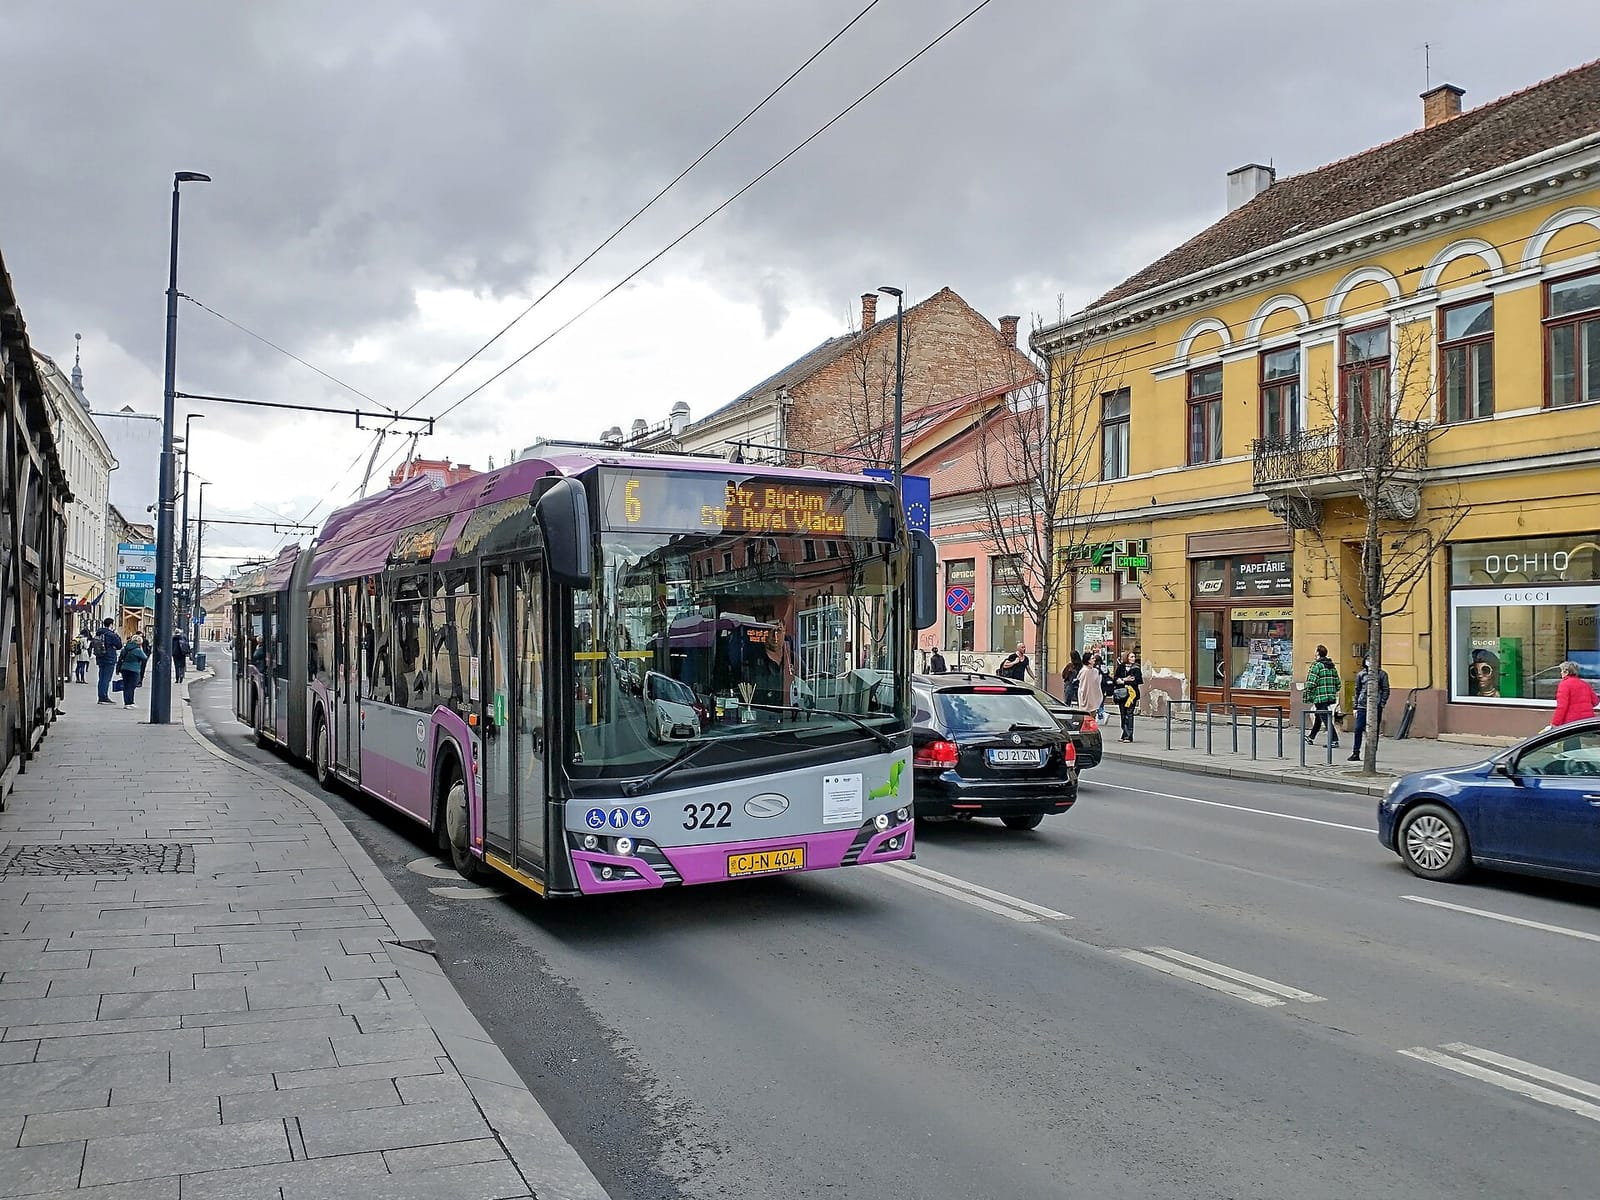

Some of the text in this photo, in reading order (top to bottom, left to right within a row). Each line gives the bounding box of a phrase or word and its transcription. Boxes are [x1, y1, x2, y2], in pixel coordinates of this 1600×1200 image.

[624, 480, 641, 523] 6
[724, 486, 824, 511] Str. Bucium
[701, 504, 845, 532] Str. Aurel Vlaicu
[1118, 557, 1147, 567] CATENA
[1240, 561, 1286, 574] PAPETĂRIE
[1486, 551, 1569, 574] OCHIO
[1504, 591, 1550, 601] GUCCI
[995, 604, 1026, 616] OPTICA
[415, 747, 426, 769] 322
[997, 751, 1009, 761] CJ
[1011, 751, 1020, 761] 21
[682, 801, 732, 830] 322
[738, 854, 769, 871] CJ-N
[774, 851, 796, 867] 404
